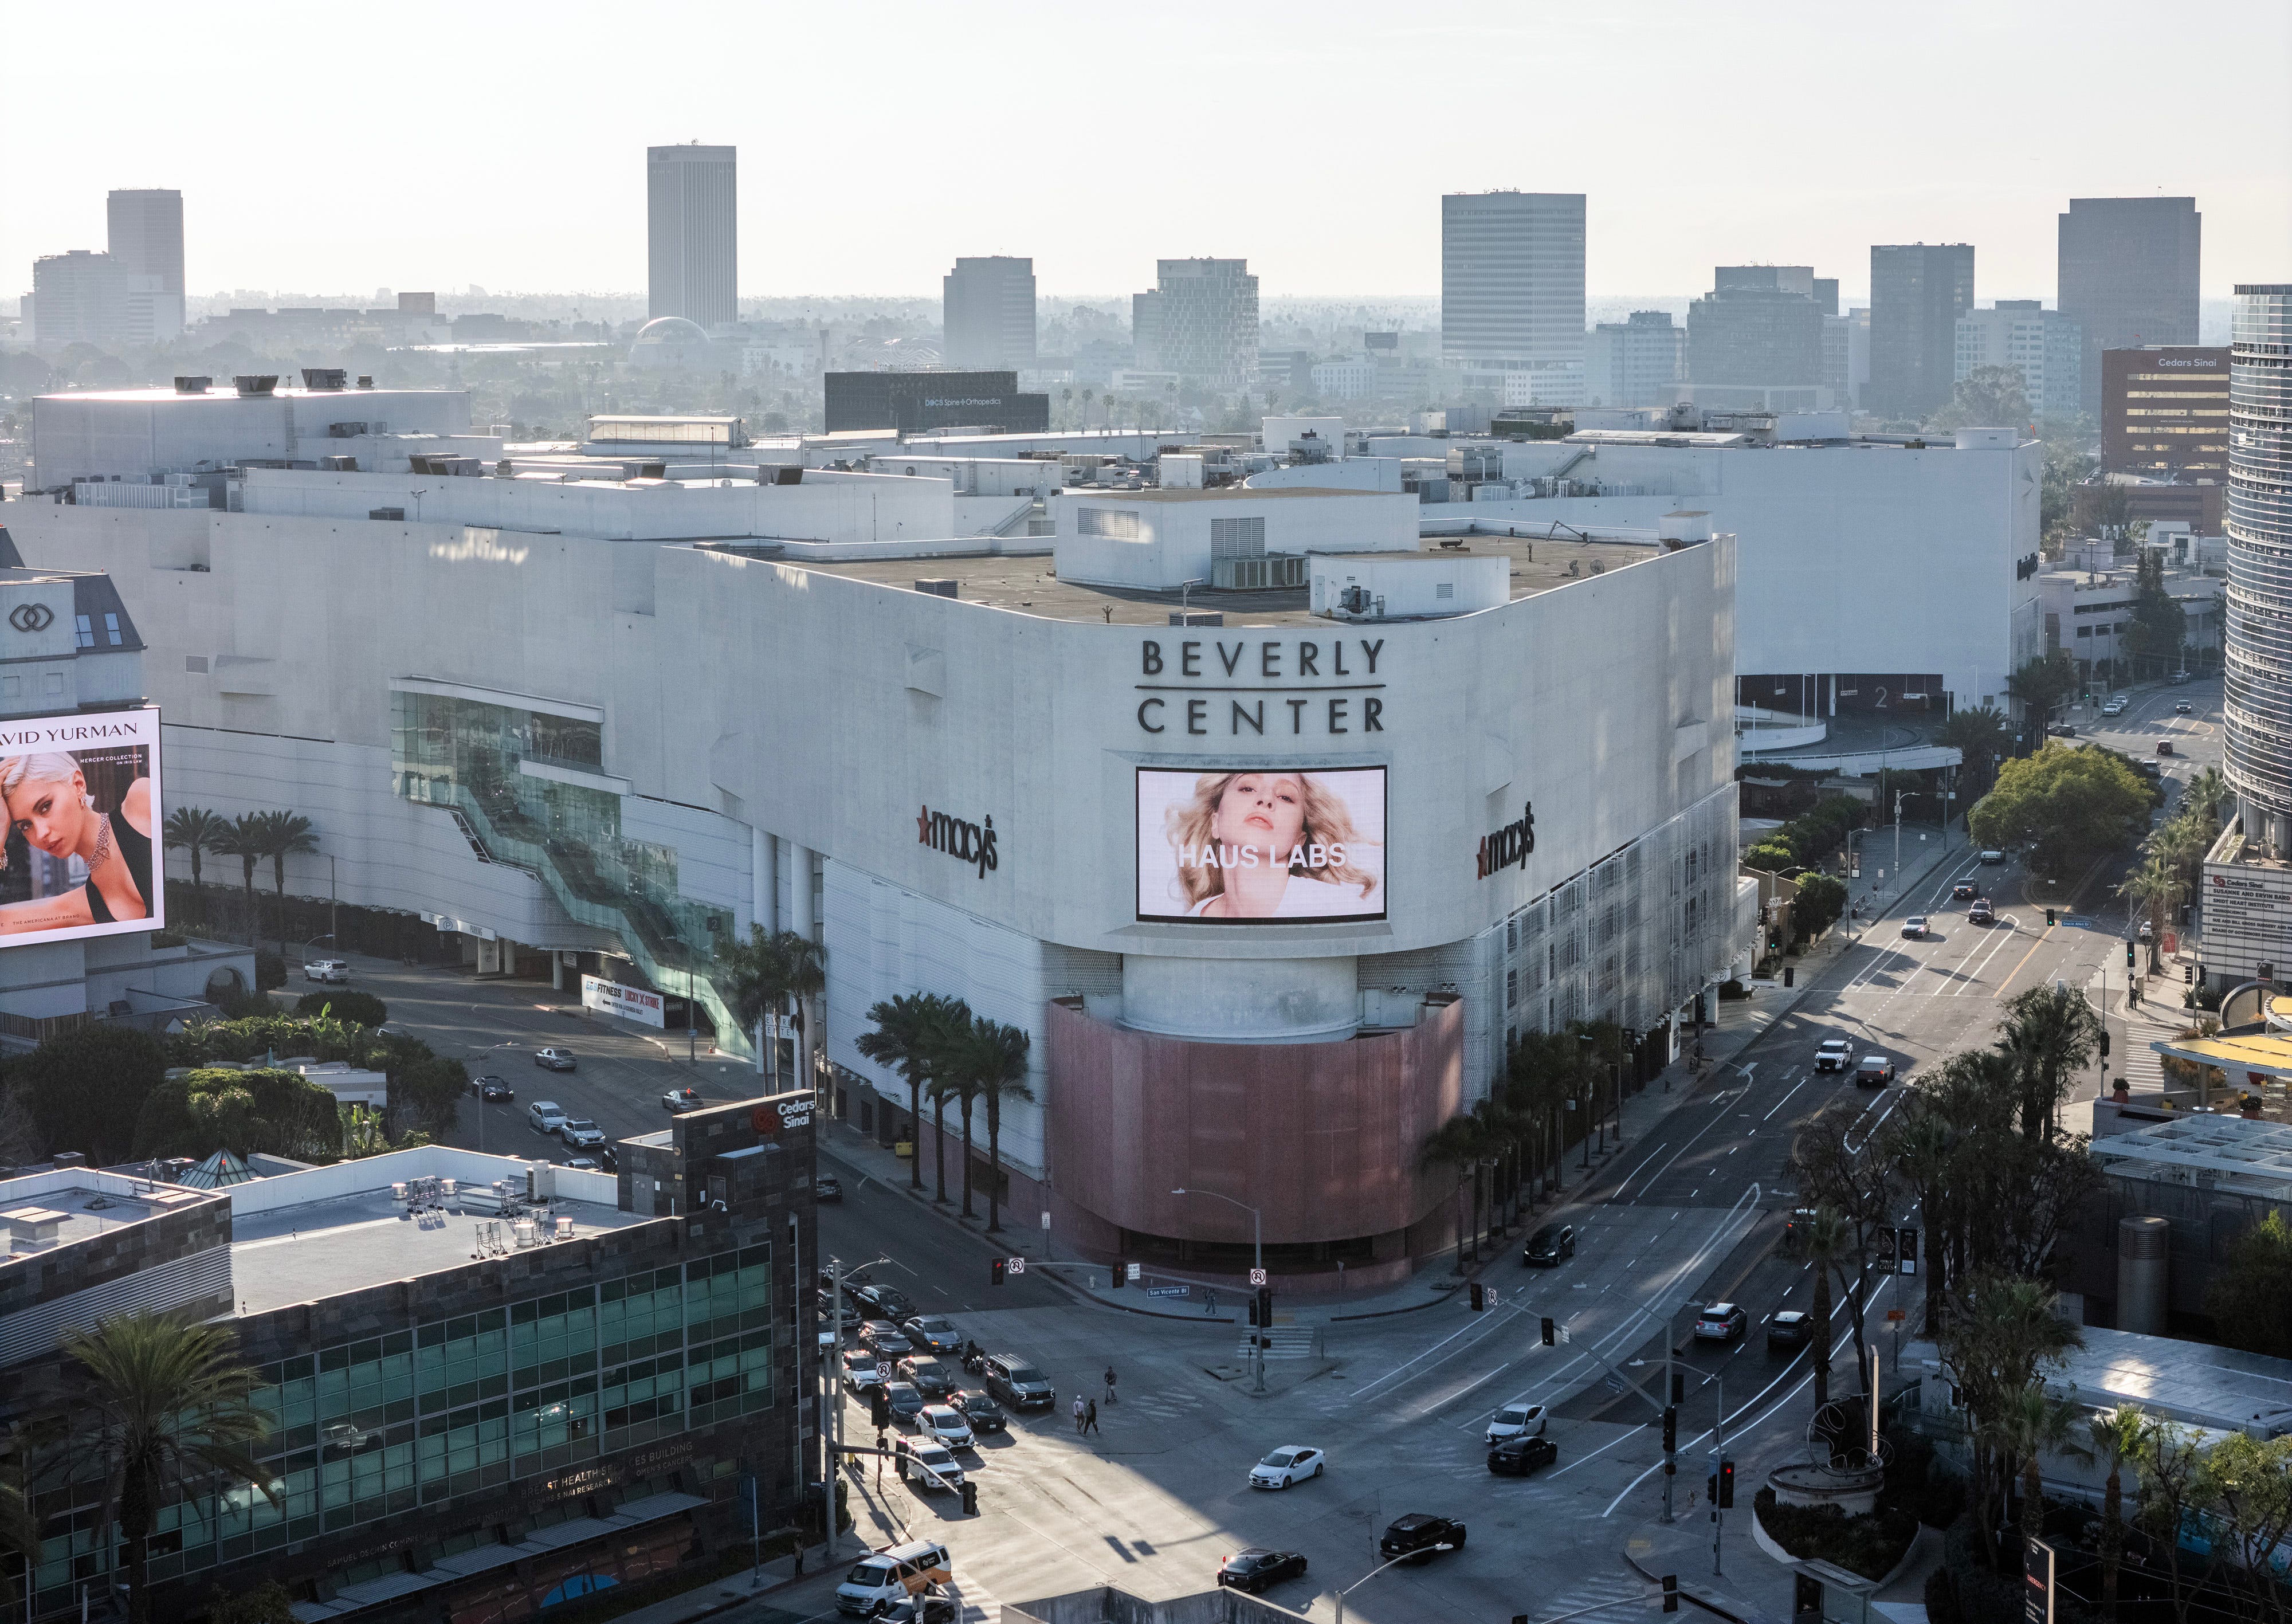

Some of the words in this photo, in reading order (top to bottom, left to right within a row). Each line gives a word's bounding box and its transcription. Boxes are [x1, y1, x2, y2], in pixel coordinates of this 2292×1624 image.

[2158, 358, 2192, 367] Cedars
[2193, 358, 2216, 367] Sinai
[944, 399, 960, 407] Spine
[966, 398, 1001, 406] Orthopedics
[1143, 639, 1384, 677] BEVERLY
[1875, 687, 1887, 708] 2
[1137, 697, 1384, 735] CENTER
[46, 723, 138, 742] YURMAN
[80, 756, 104, 764] MERCER
[105, 754, 142, 762] COLLECTION
[932, 811, 998, 879] macy's
[1488, 801, 1534, 875] macy's
[1179, 844, 1259, 869] HAUS
[1269, 843, 1346, 868] LABS
[712, 920, 717, 929] 2
[597, 983, 622, 998] FITNESS
[625, 989, 638, 1003] LUCKY
[645, 996, 660, 1010] STRIKE
[777, 1100, 815, 1116] Cedars
[783, 1112, 810, 1129] Sinai
[805, 1438, 814, 1446] 310
[521, 1480, 559, 1499] BREAST
[562, 1468, 598, 1488] HEALTH
[649, 1442, 693, 1462] BUILDING
[576, 1477, 611, 1494] RESEARCH
[662, 1454, 693, 1469] CANCERS
[327, 1552, 358, 1568] SAMUEL
[359, 1543, 387, 1558] OSCHIN
[2027, 1574, 2046, 1592] EMERGENCY
